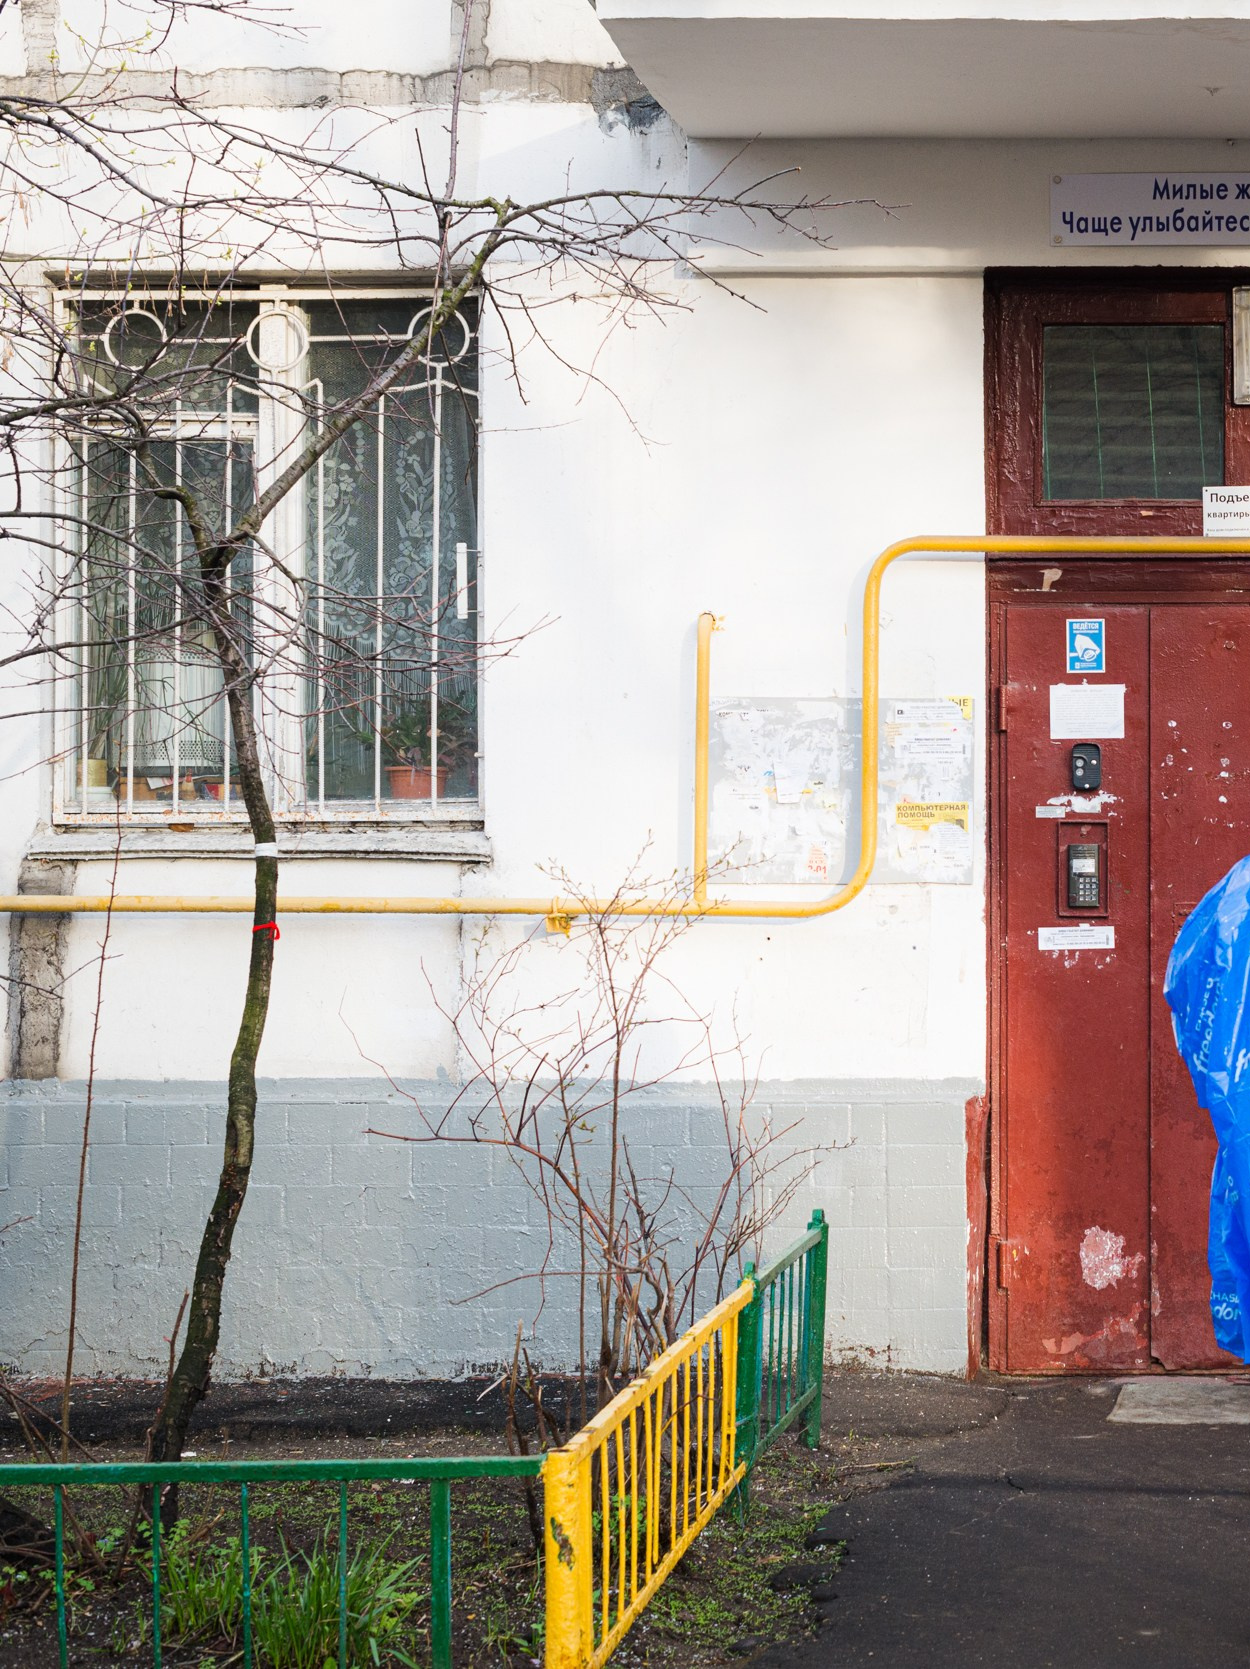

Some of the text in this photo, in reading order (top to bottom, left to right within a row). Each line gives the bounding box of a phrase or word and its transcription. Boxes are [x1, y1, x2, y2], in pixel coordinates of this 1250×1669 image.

[1152, 177, 1229, 201] Милые
[1062, 211, 1123, 236] Чаще
[896, 804, 967, 812] КОМПЬЮТЕРНАЯ
[897, 811, 936, 819] ПОМОЩЬ
